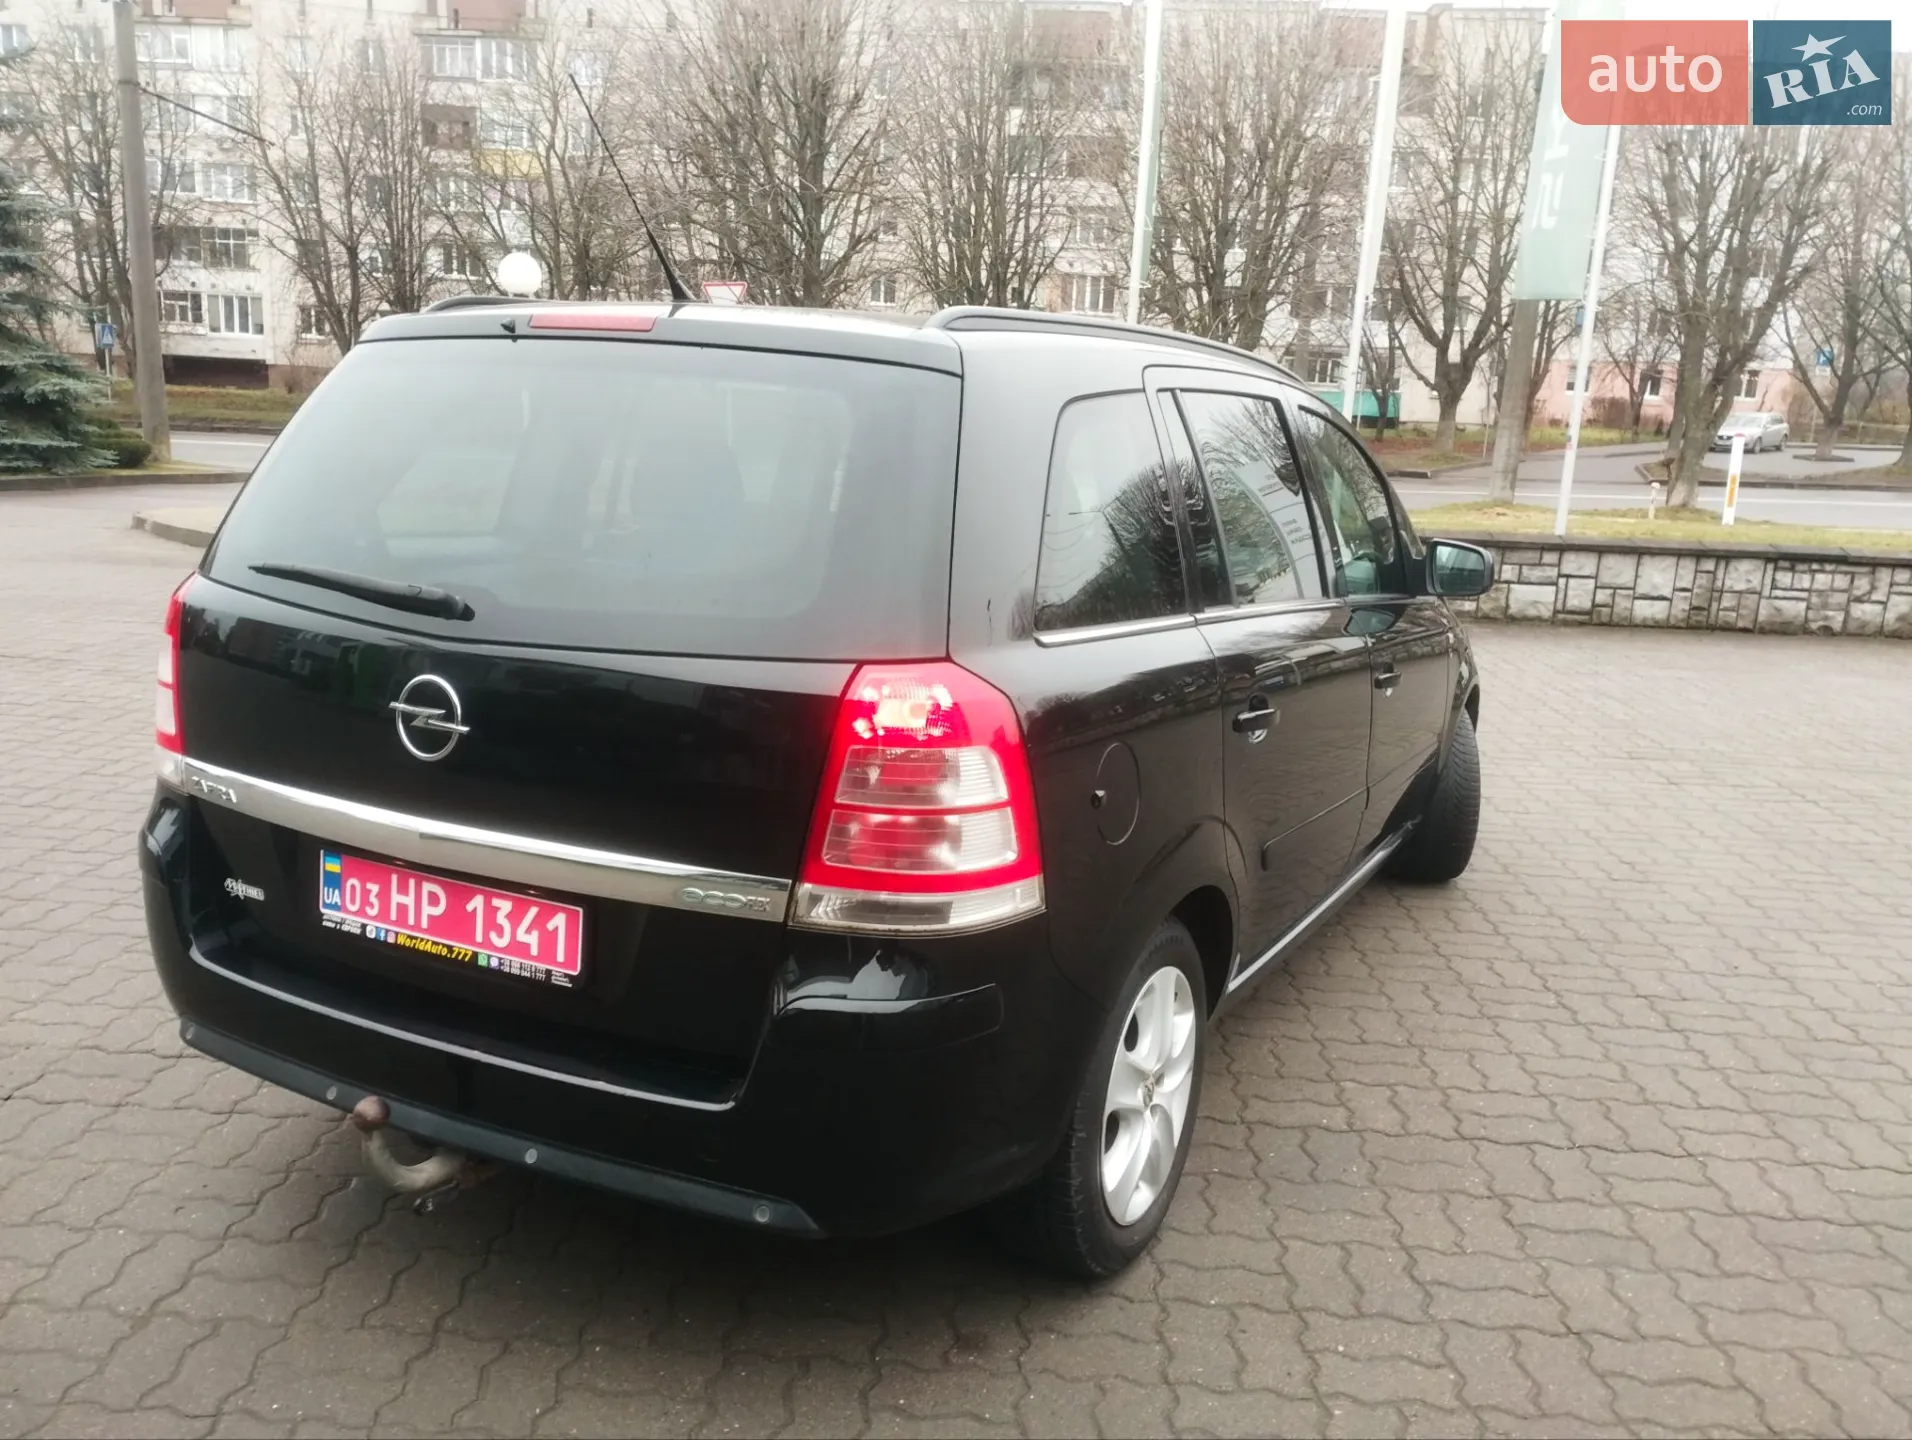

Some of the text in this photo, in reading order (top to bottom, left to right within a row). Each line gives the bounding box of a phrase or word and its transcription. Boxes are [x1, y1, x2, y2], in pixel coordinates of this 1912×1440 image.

[324, 887, 341, 907] UA
[345, 873, 567, 963] 03 HP 1341
